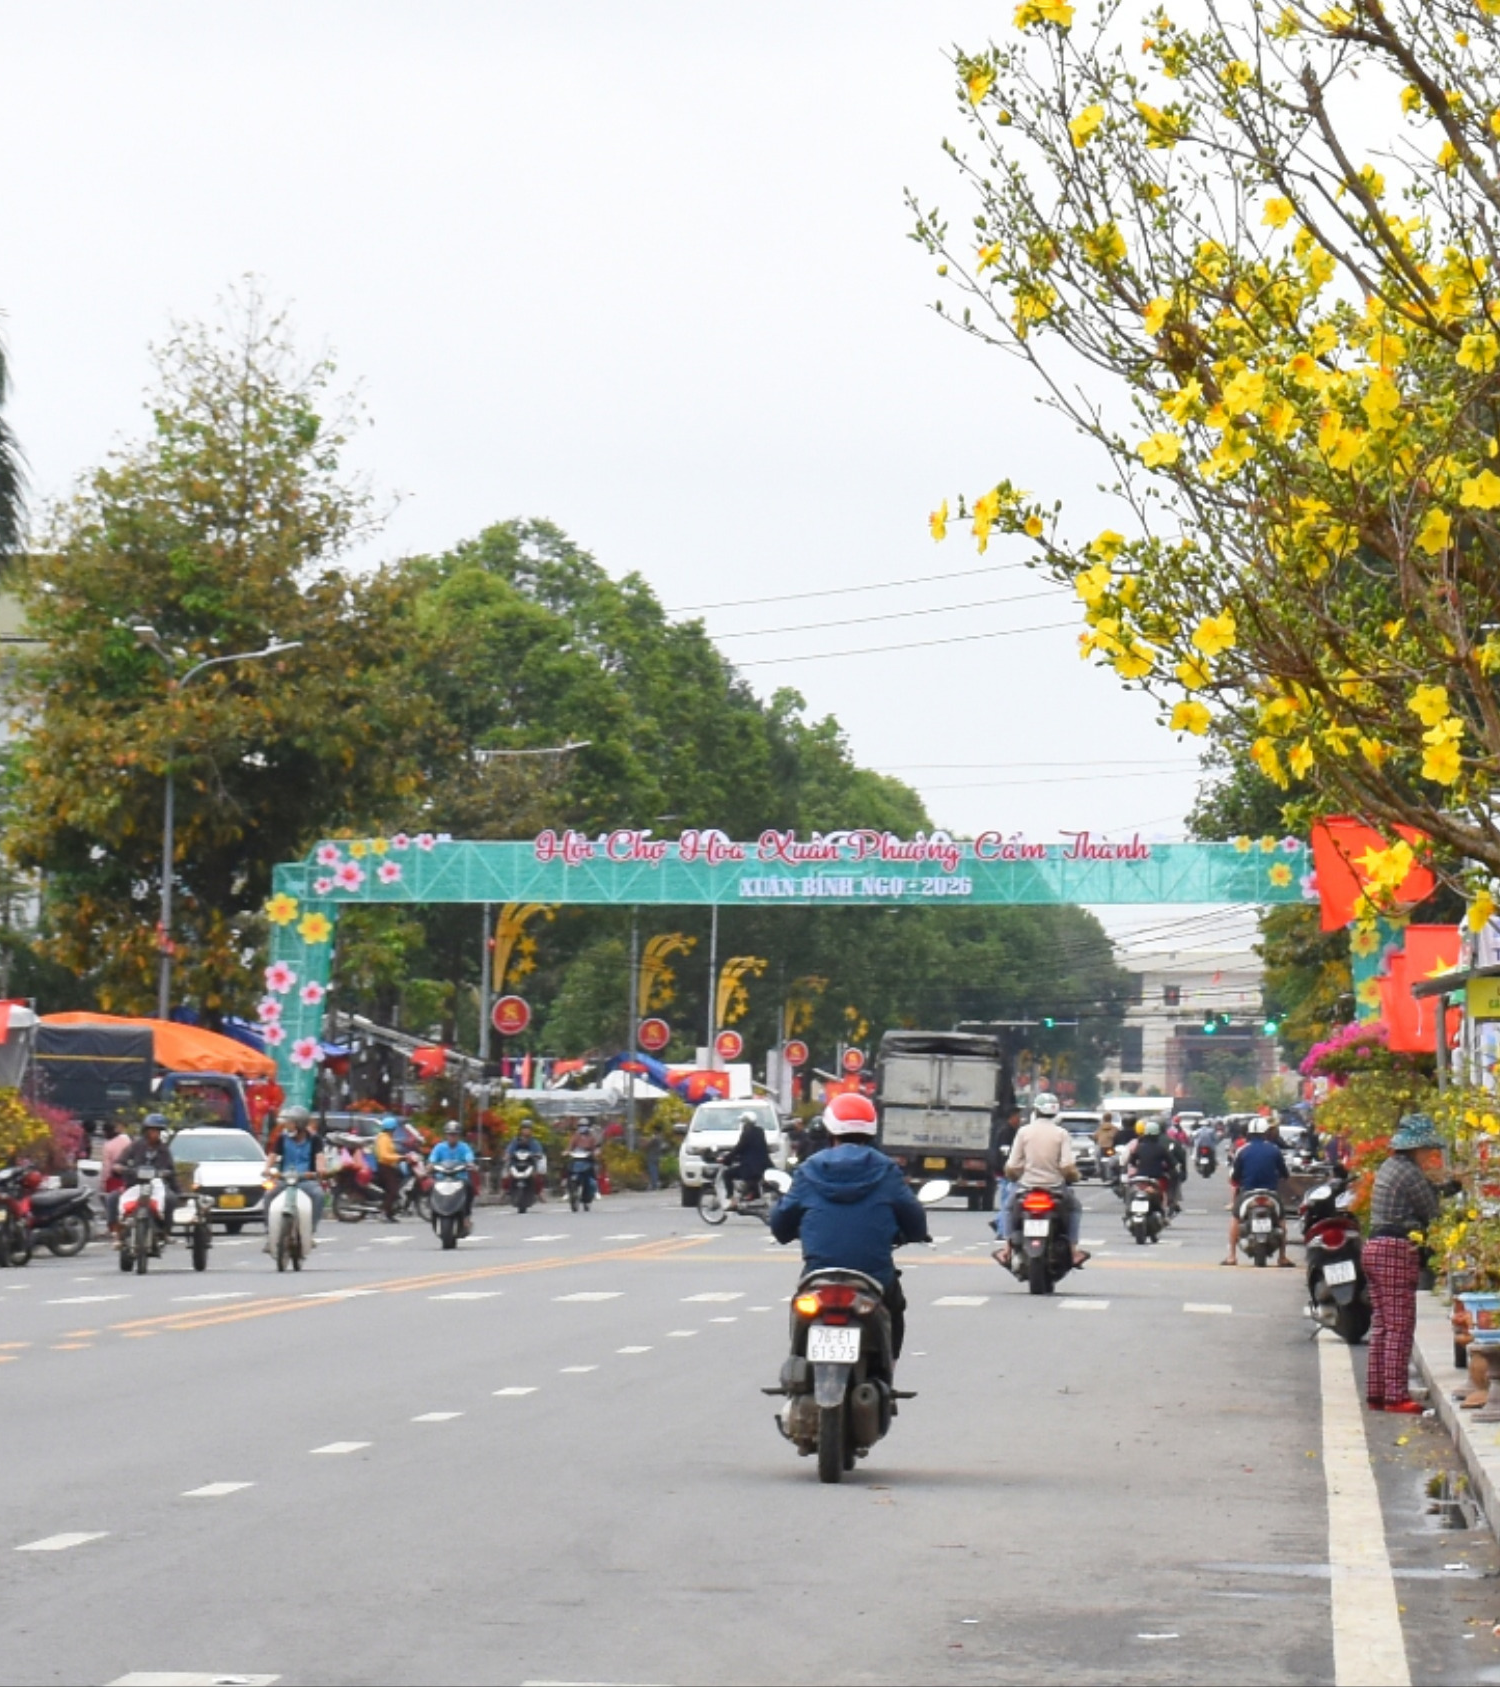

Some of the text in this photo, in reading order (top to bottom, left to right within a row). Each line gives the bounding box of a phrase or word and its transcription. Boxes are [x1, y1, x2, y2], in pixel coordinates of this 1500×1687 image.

[534, 829, 1150, 873] Hội Chợ Hoa Xuân Phường Cẩm Thành
[739, 875, 795, 897] XUÂN
[860, 876, 904, 899] NGỌ
[921, 876, 973, 897] 2026
